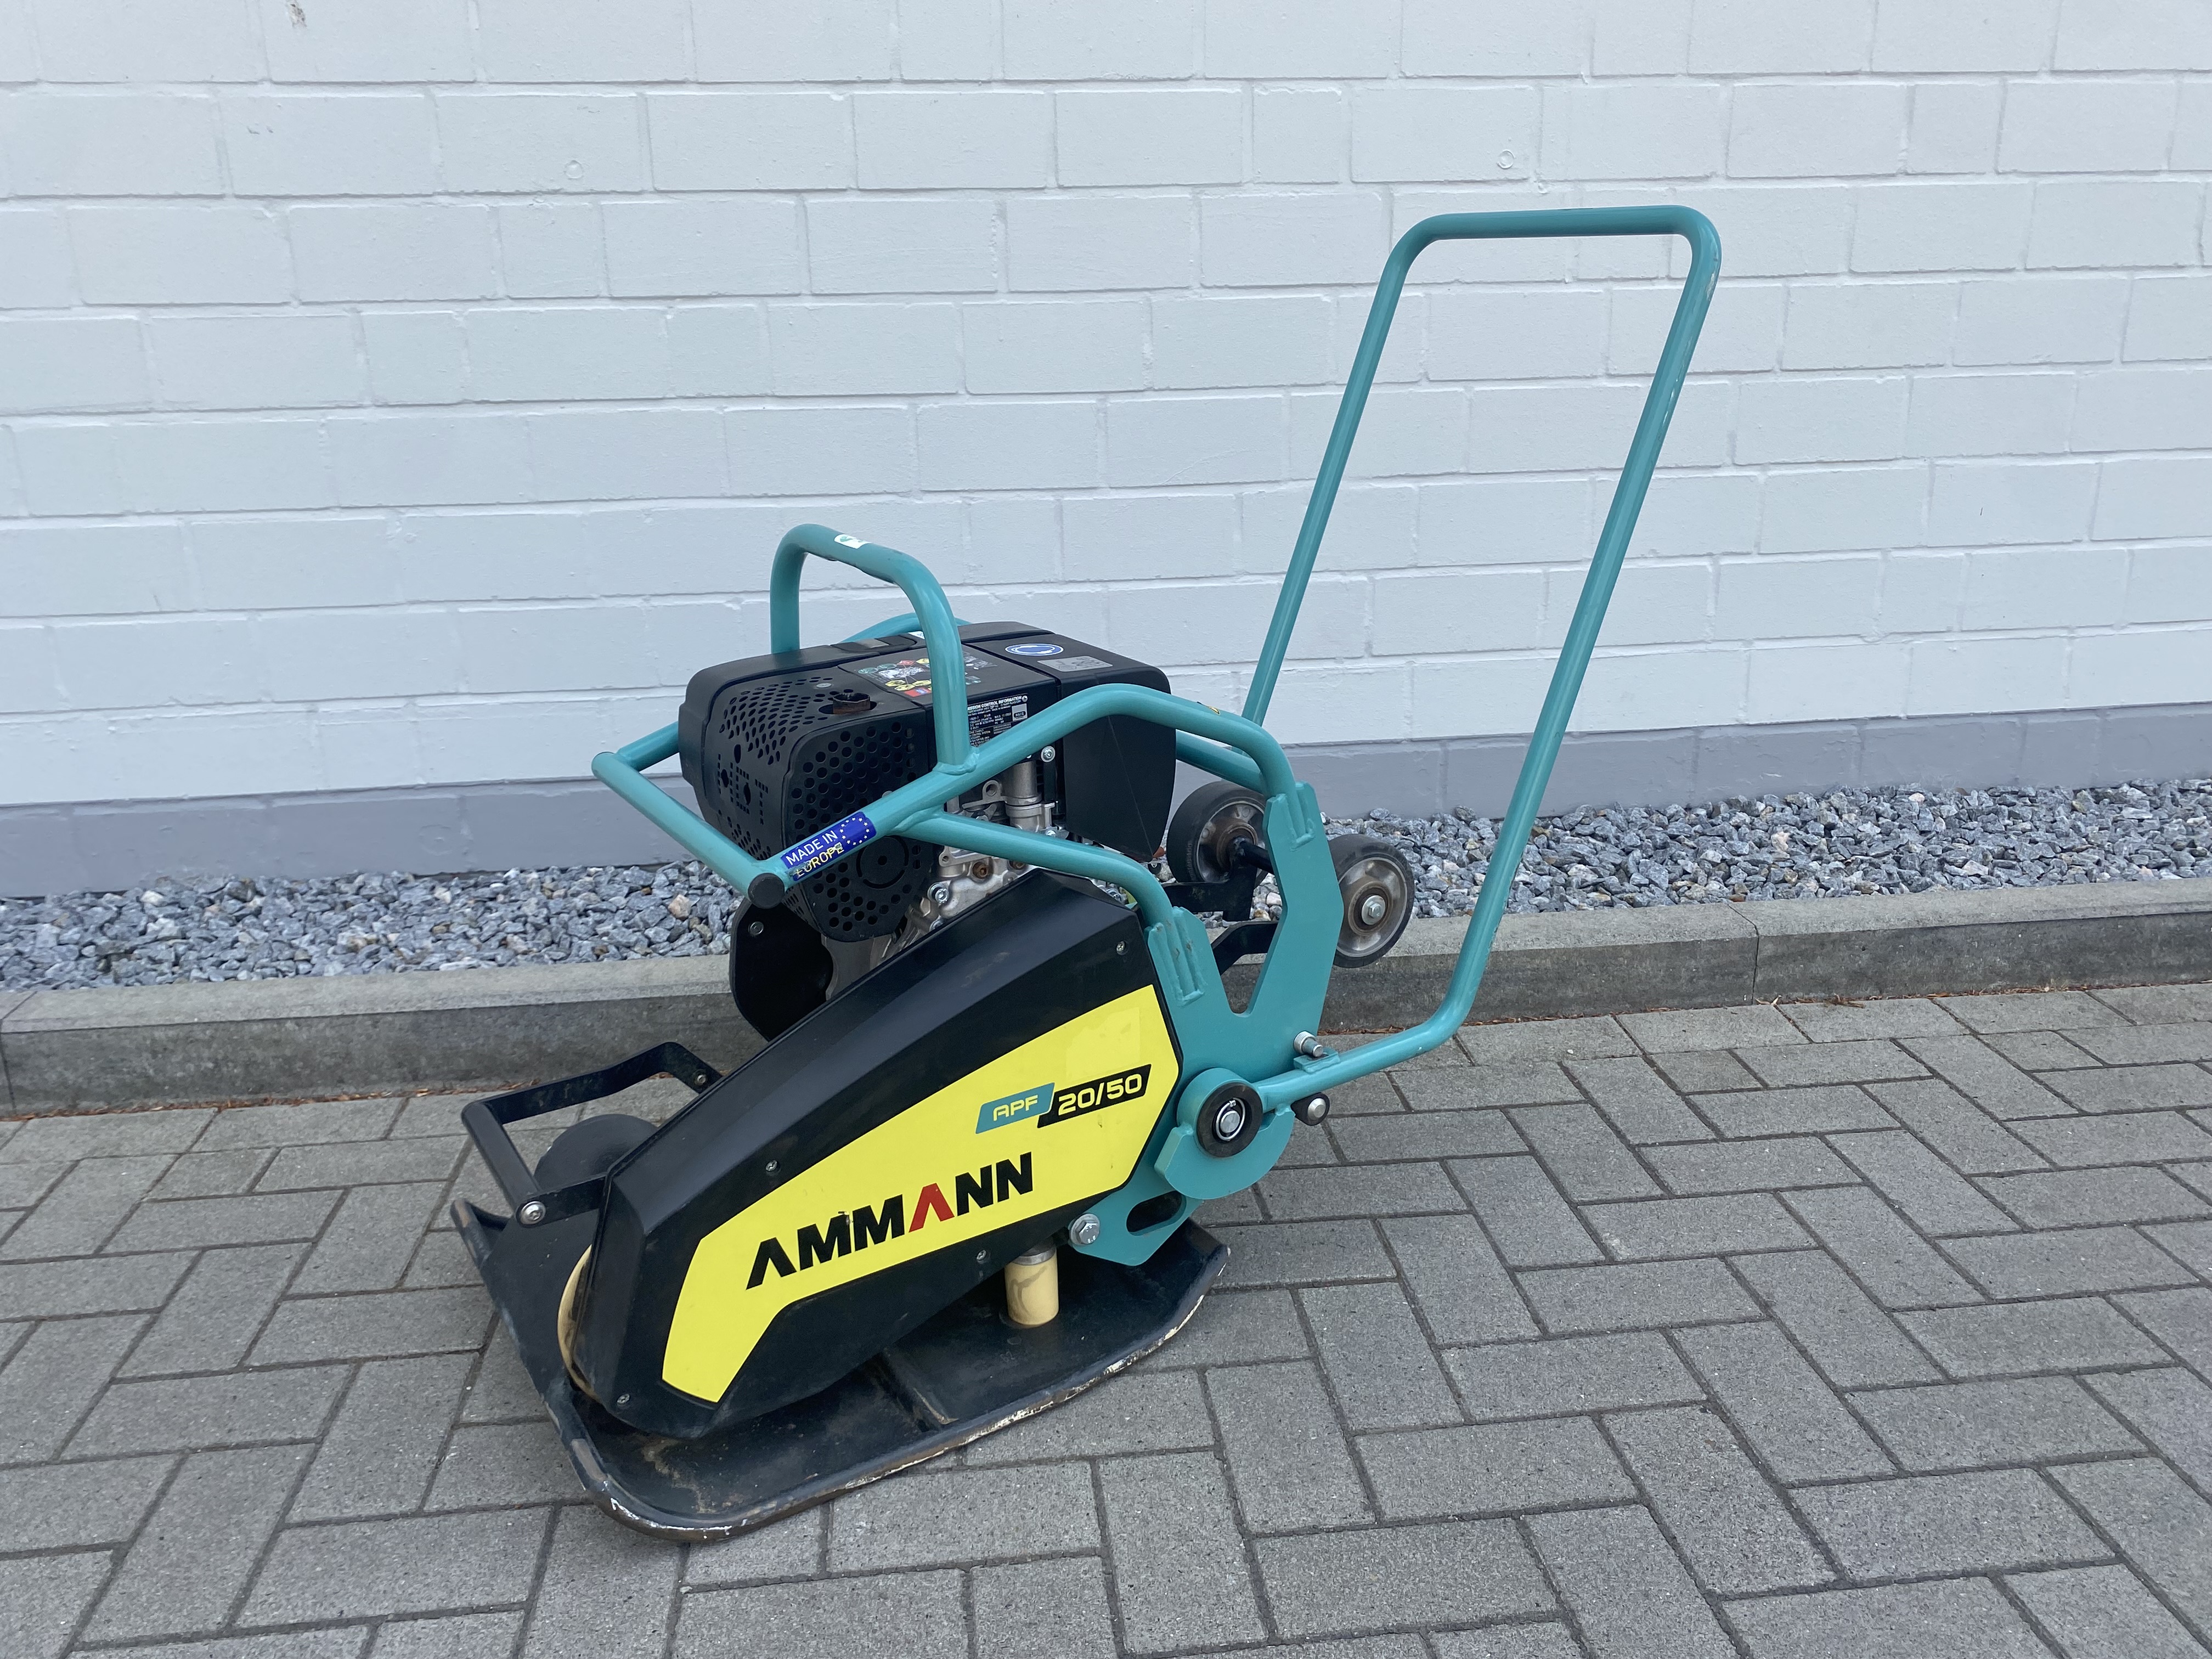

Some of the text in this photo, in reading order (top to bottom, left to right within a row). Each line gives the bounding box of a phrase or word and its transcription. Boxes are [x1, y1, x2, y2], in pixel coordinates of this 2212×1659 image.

[786, 830, 838, 865] MADE IN
[795, 842, 844, 878] EUROPE
[993, 1074, 1142, 1121] APF 20/50
[746, 1152, 1033, 1290] AMMANN
